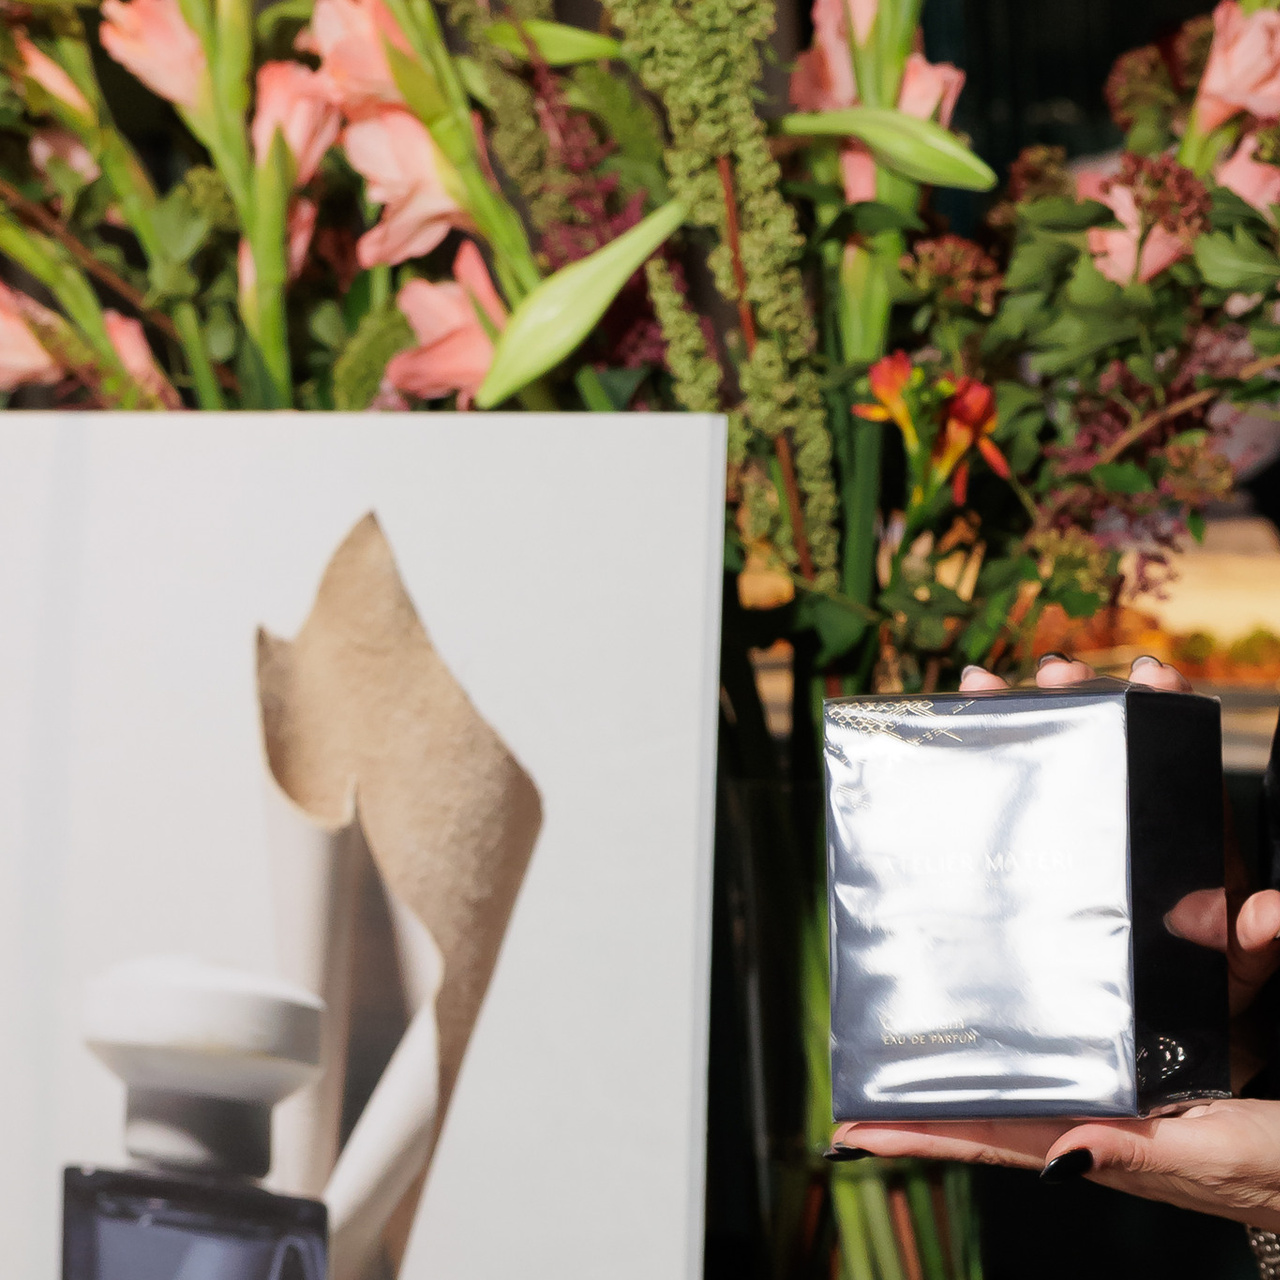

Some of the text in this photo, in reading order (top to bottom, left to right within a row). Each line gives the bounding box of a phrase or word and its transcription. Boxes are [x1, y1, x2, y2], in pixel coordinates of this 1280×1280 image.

[880, 848, 1074, 875] ATELIER MATERI
[883, 1033, 977, 1046] EAU DE PARFUM
